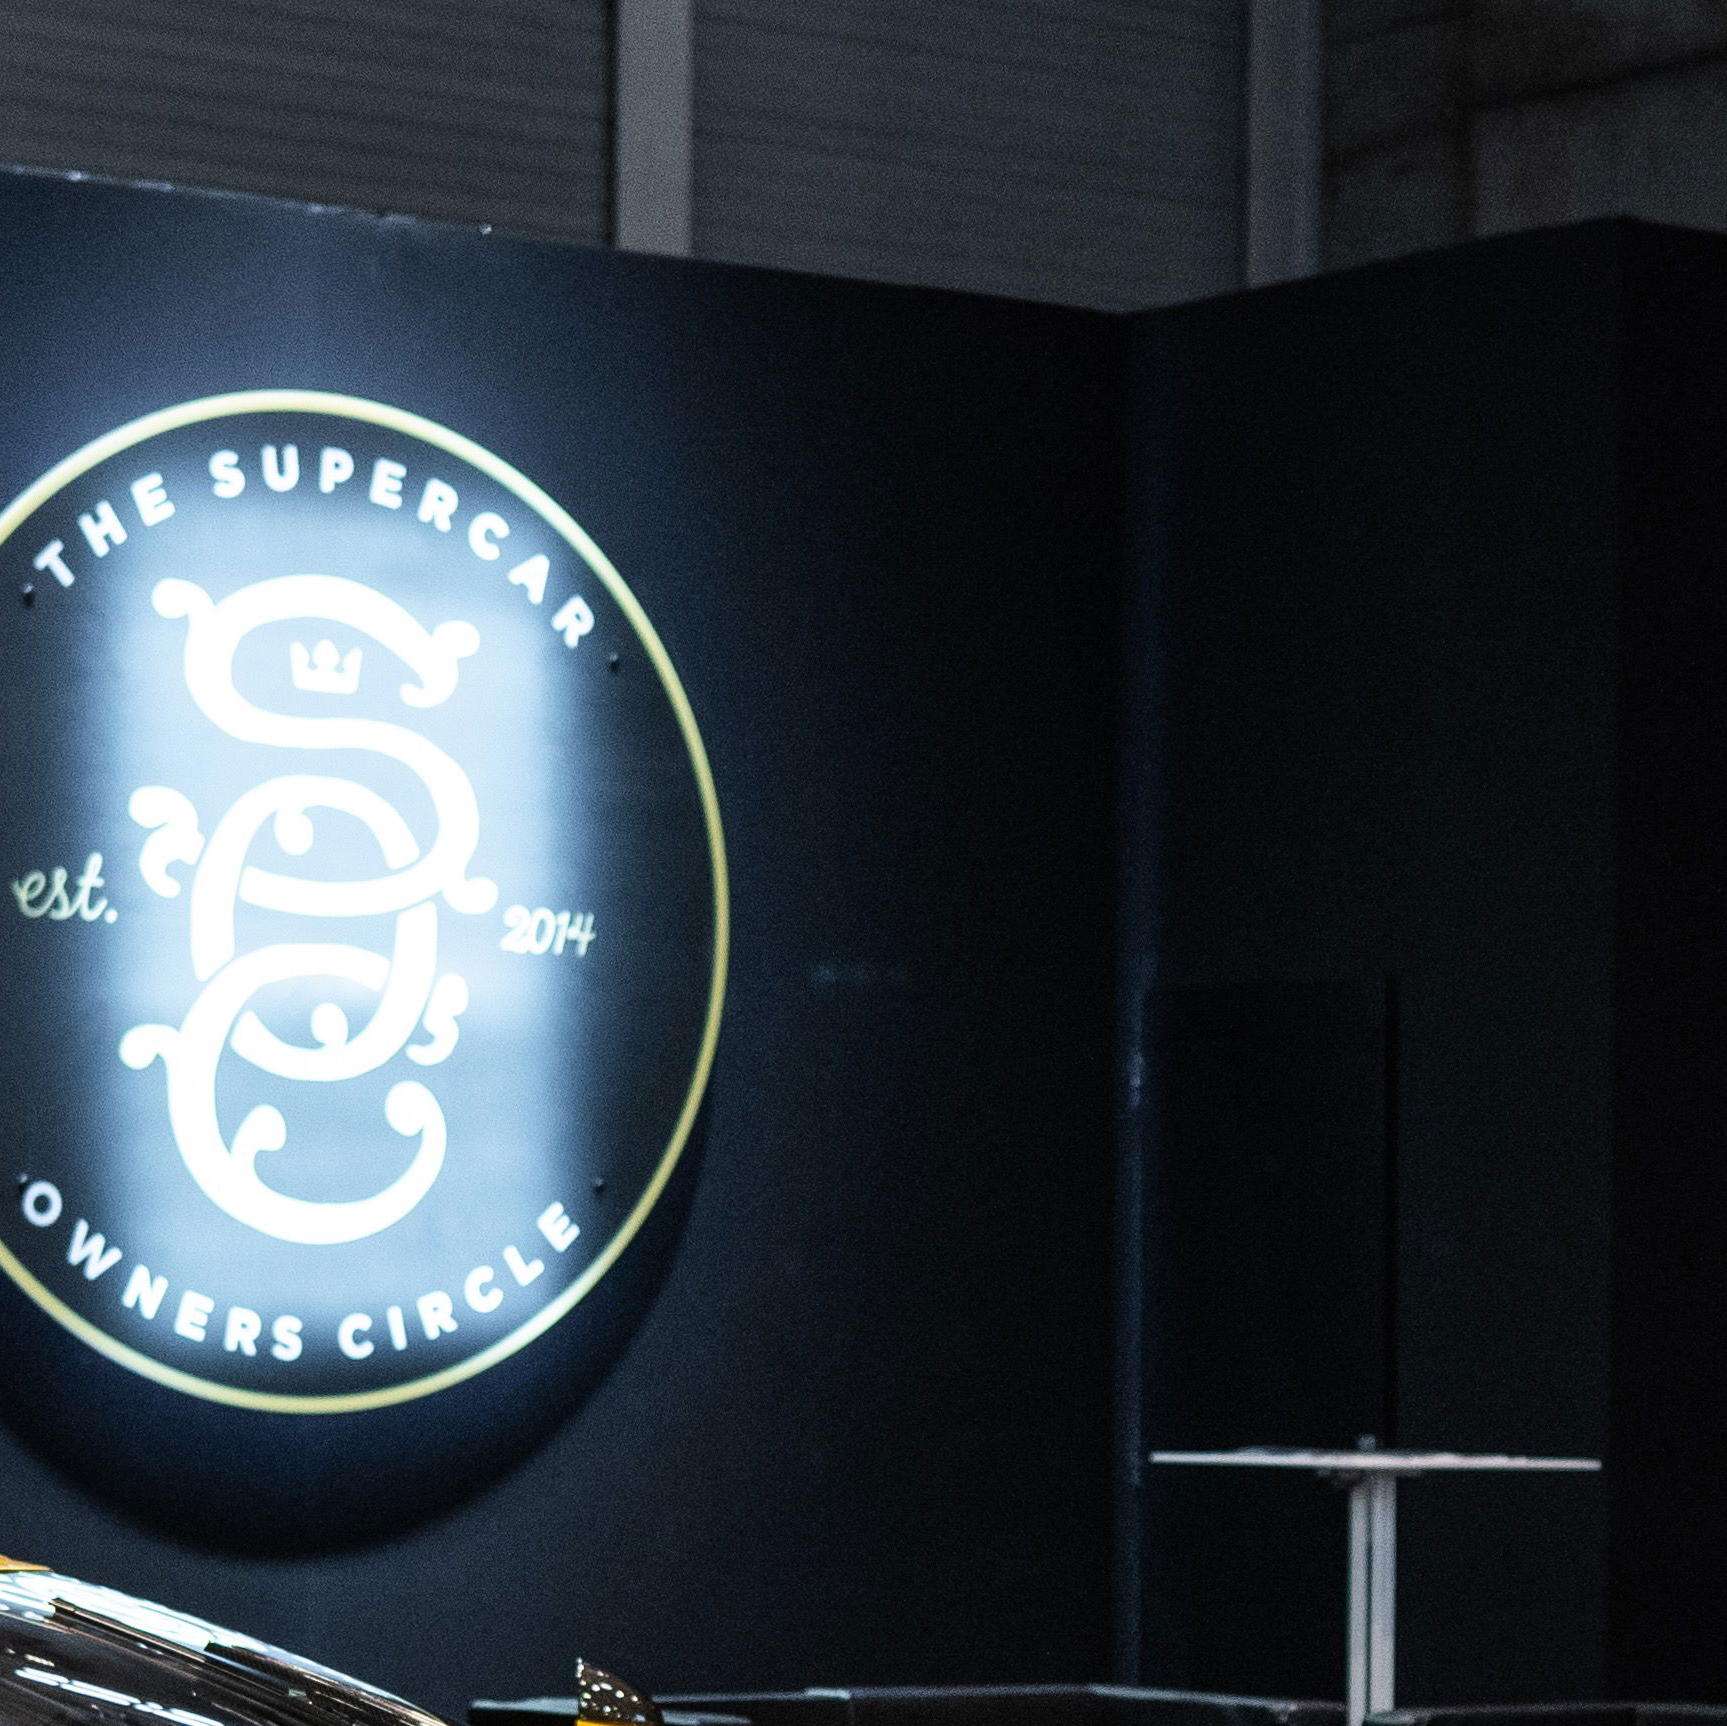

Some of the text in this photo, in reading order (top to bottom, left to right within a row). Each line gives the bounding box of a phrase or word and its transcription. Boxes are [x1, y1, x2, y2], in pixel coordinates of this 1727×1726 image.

[33, 444, 595, 648] THE SUPERCAR
[12, 851, 119, 924] est.
[499, 904, 596, 957] 2014
[22, 1180, 581, 1361] OWNERS CIRCLE
